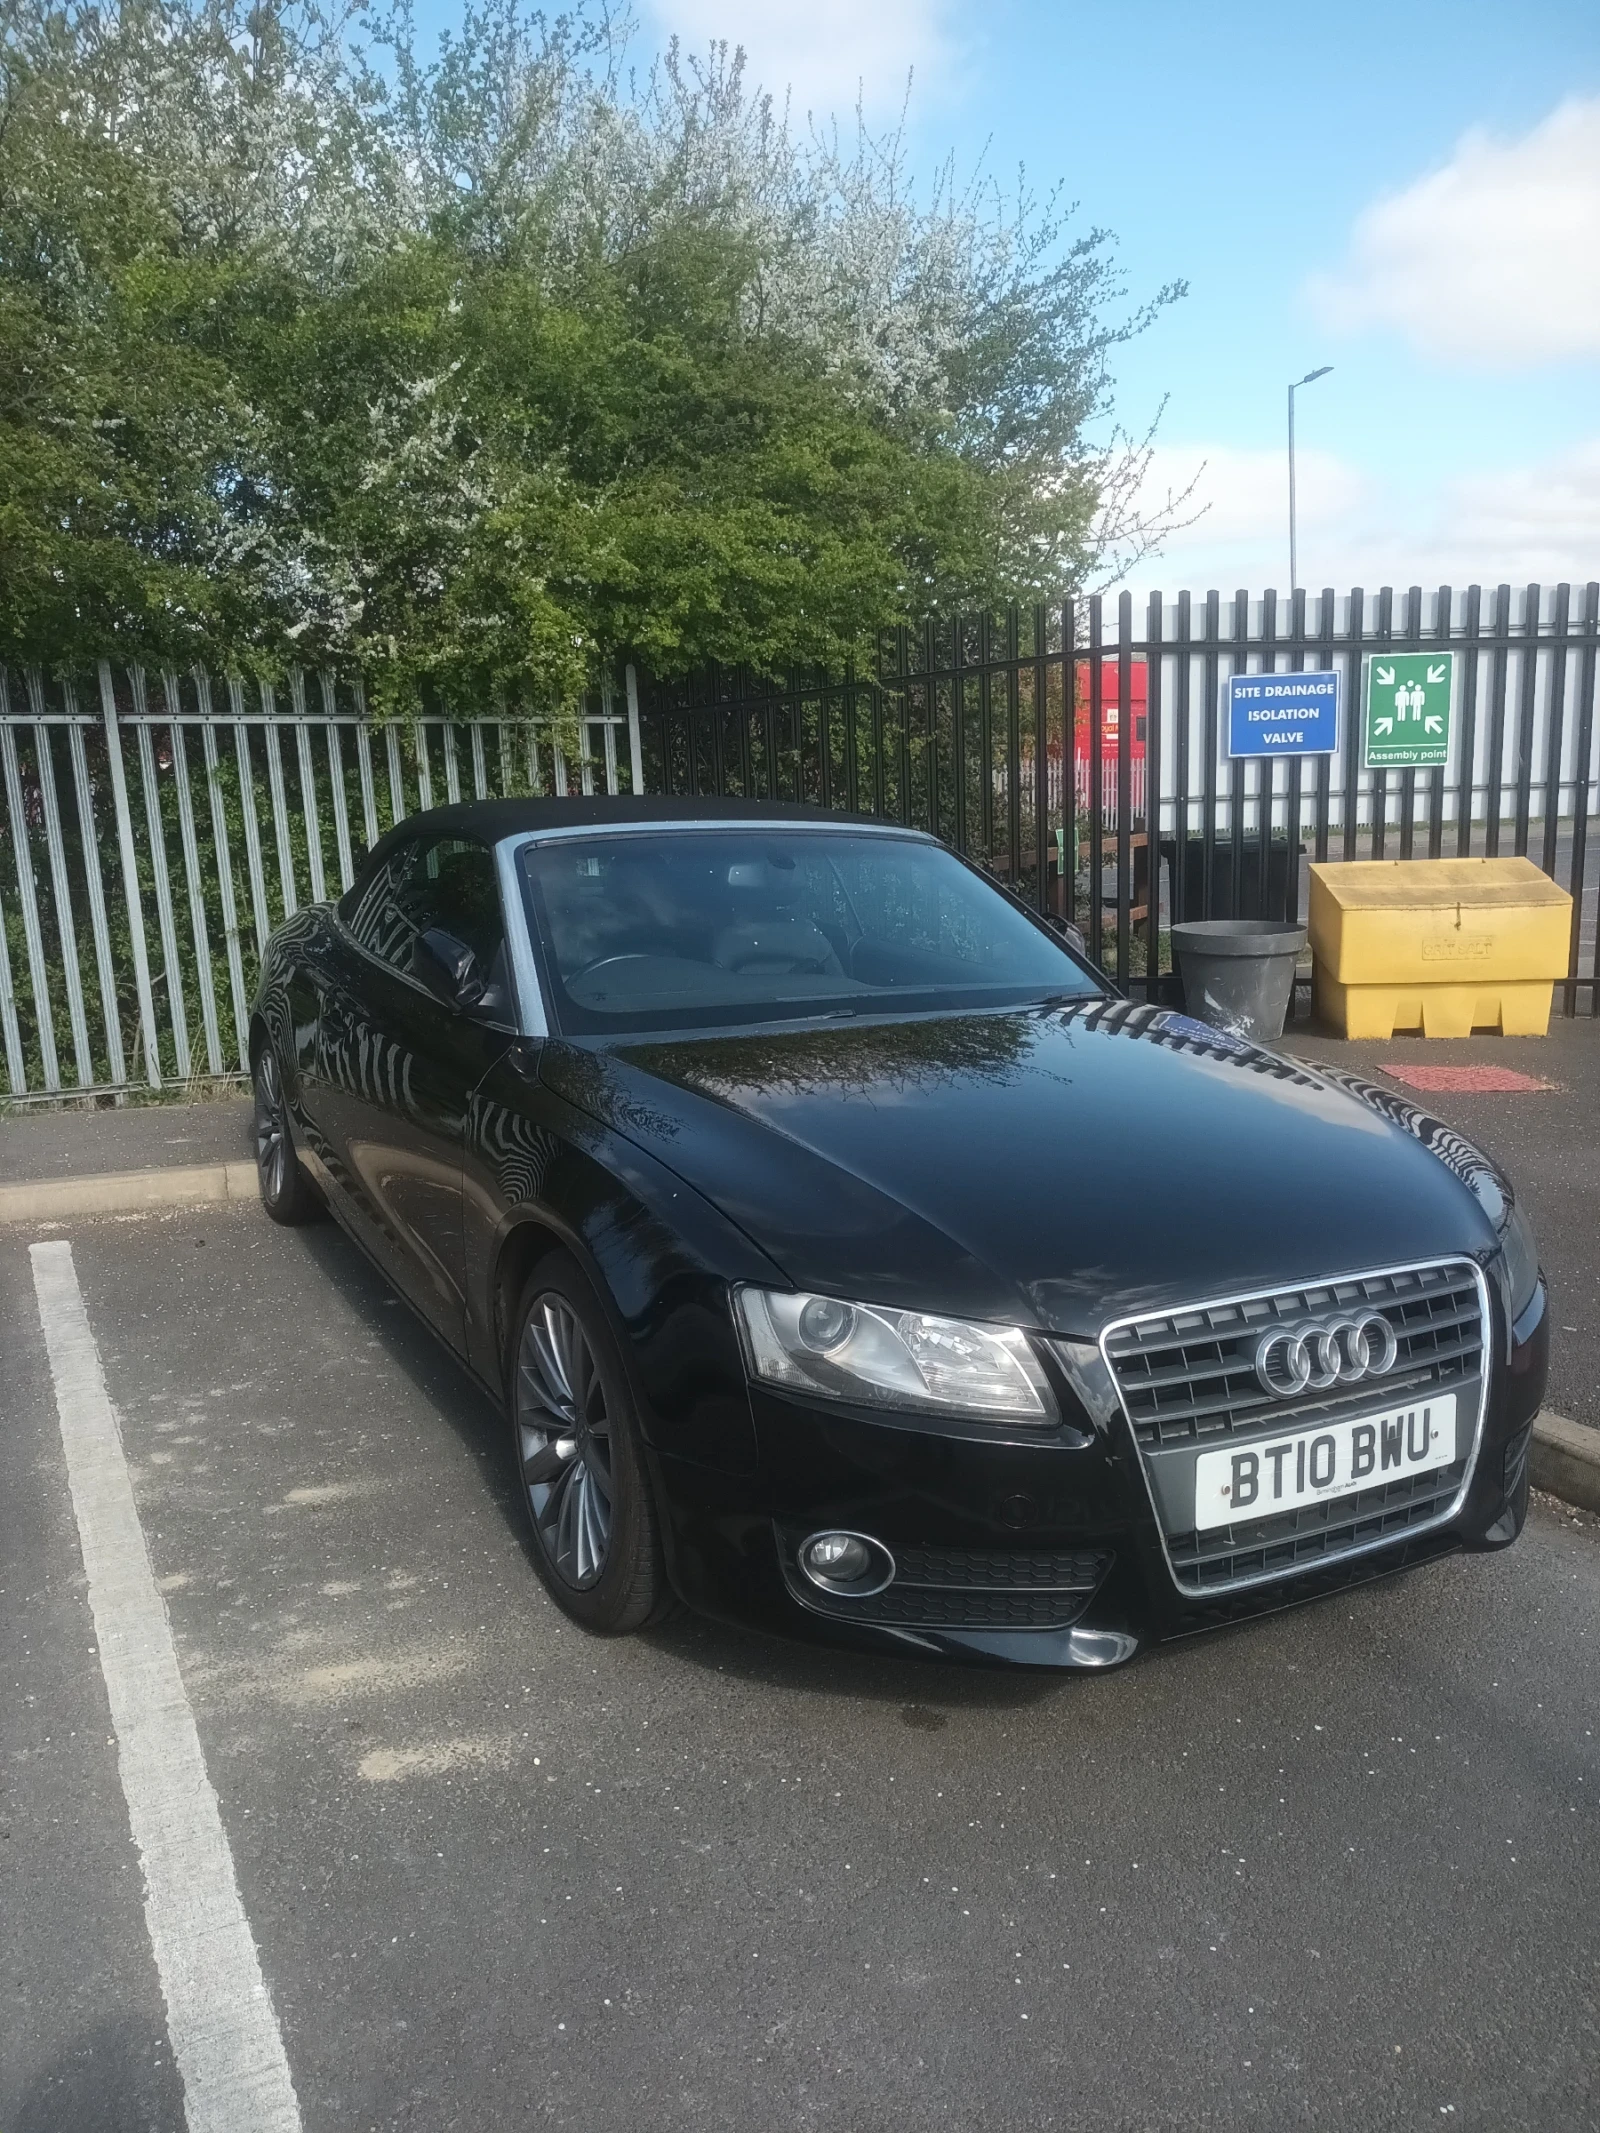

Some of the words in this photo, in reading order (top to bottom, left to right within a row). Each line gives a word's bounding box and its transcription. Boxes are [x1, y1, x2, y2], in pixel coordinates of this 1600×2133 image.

[1234, 686, 1261, 699] SITE
[1264, 683, 1335, 697] DRAINAGE
[1248, 708, 1320, 722] ISOLATION
[1262, 731, 1304, 744] VALVE
[1369, 750, 1418, 761] Assembly
[1420, 749, 1447, 761] point
[1423, 943, 1456, 955] GRIT
[1458, 942, 1492, 955] SALT
[1230, 1434, 1336, 1509] BT10
[1351, 1407, 1431, 1479] BWU
